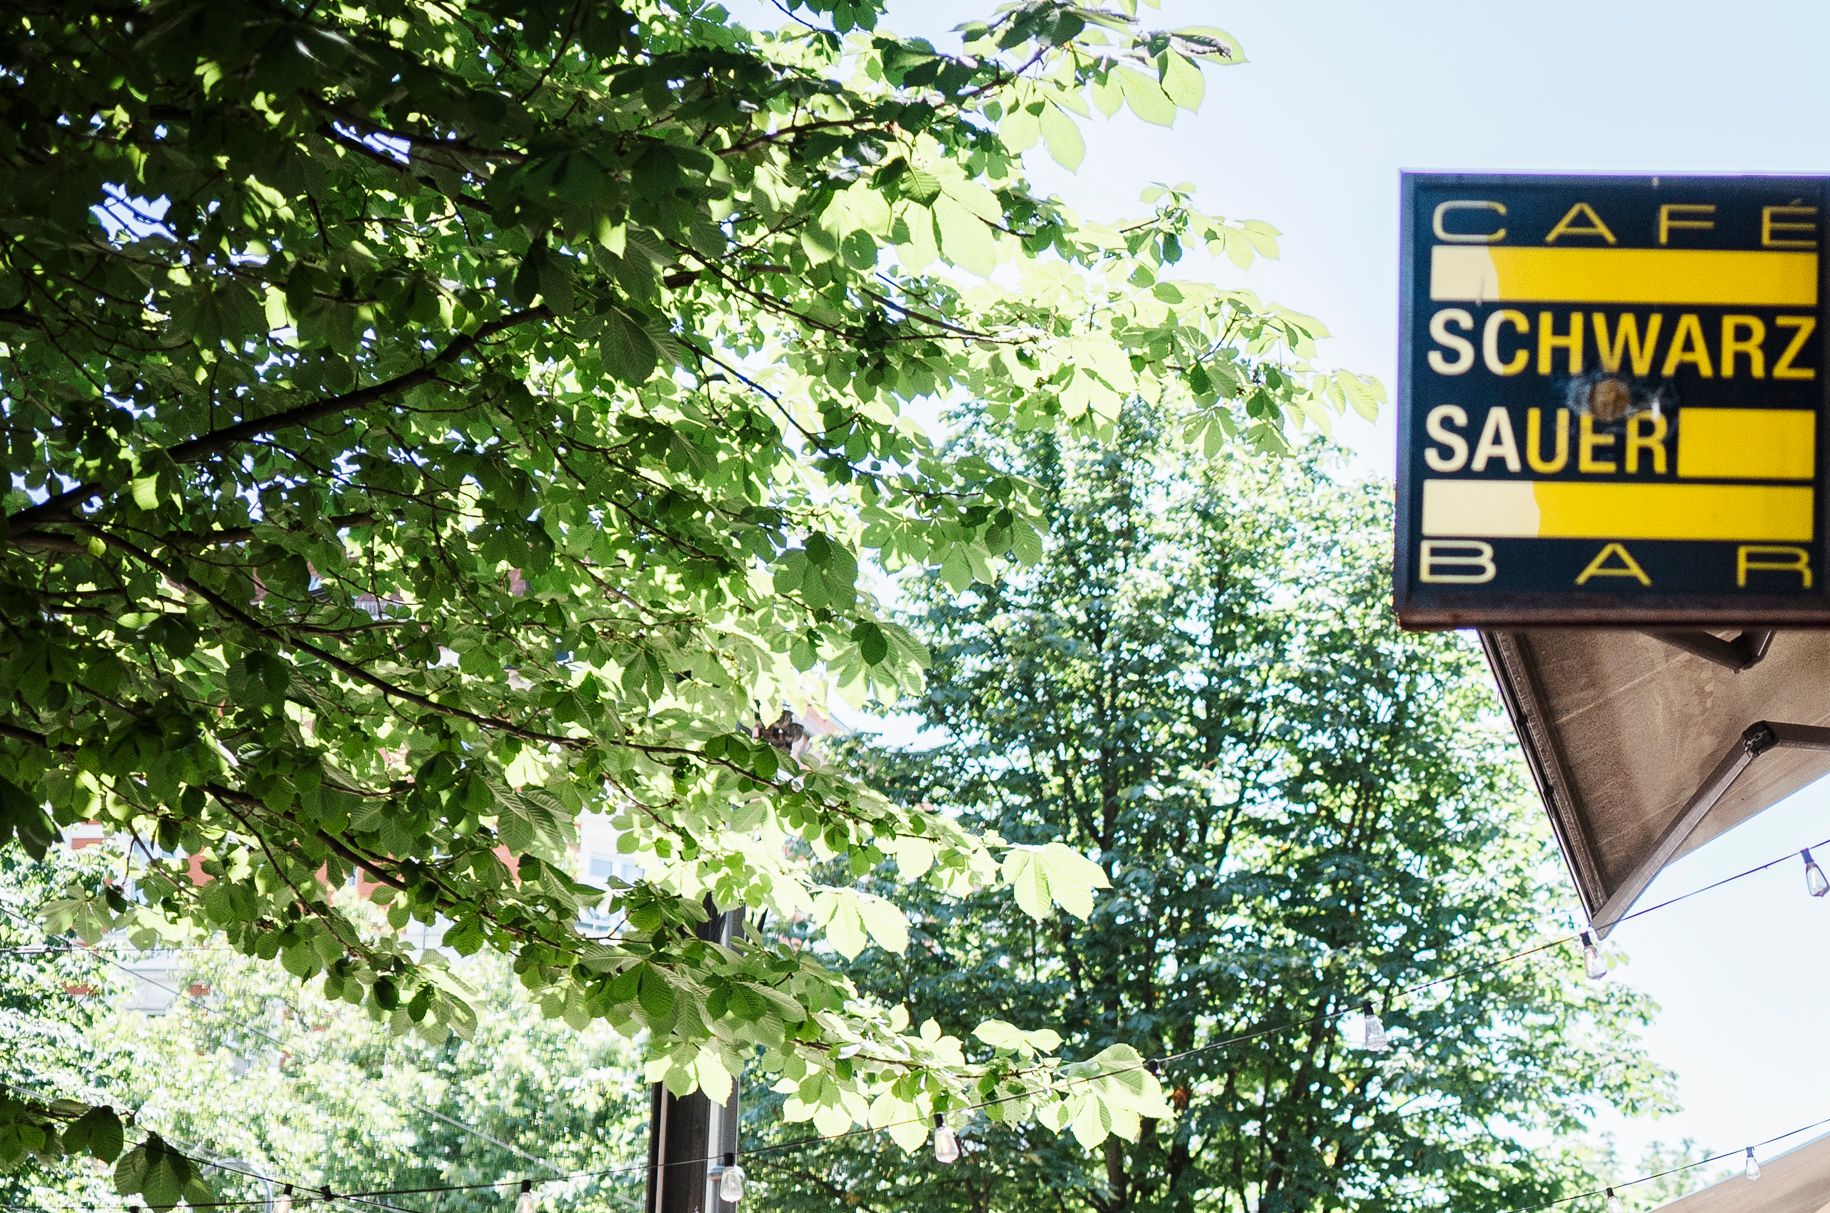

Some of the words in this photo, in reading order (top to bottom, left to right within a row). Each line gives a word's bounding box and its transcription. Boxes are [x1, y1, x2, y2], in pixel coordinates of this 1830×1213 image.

[1427, 307, 1817, 380] SCHWARZ
[1424, 404, 1669, 475] SAUER
[1419, 539, 1813, 588] BAR
